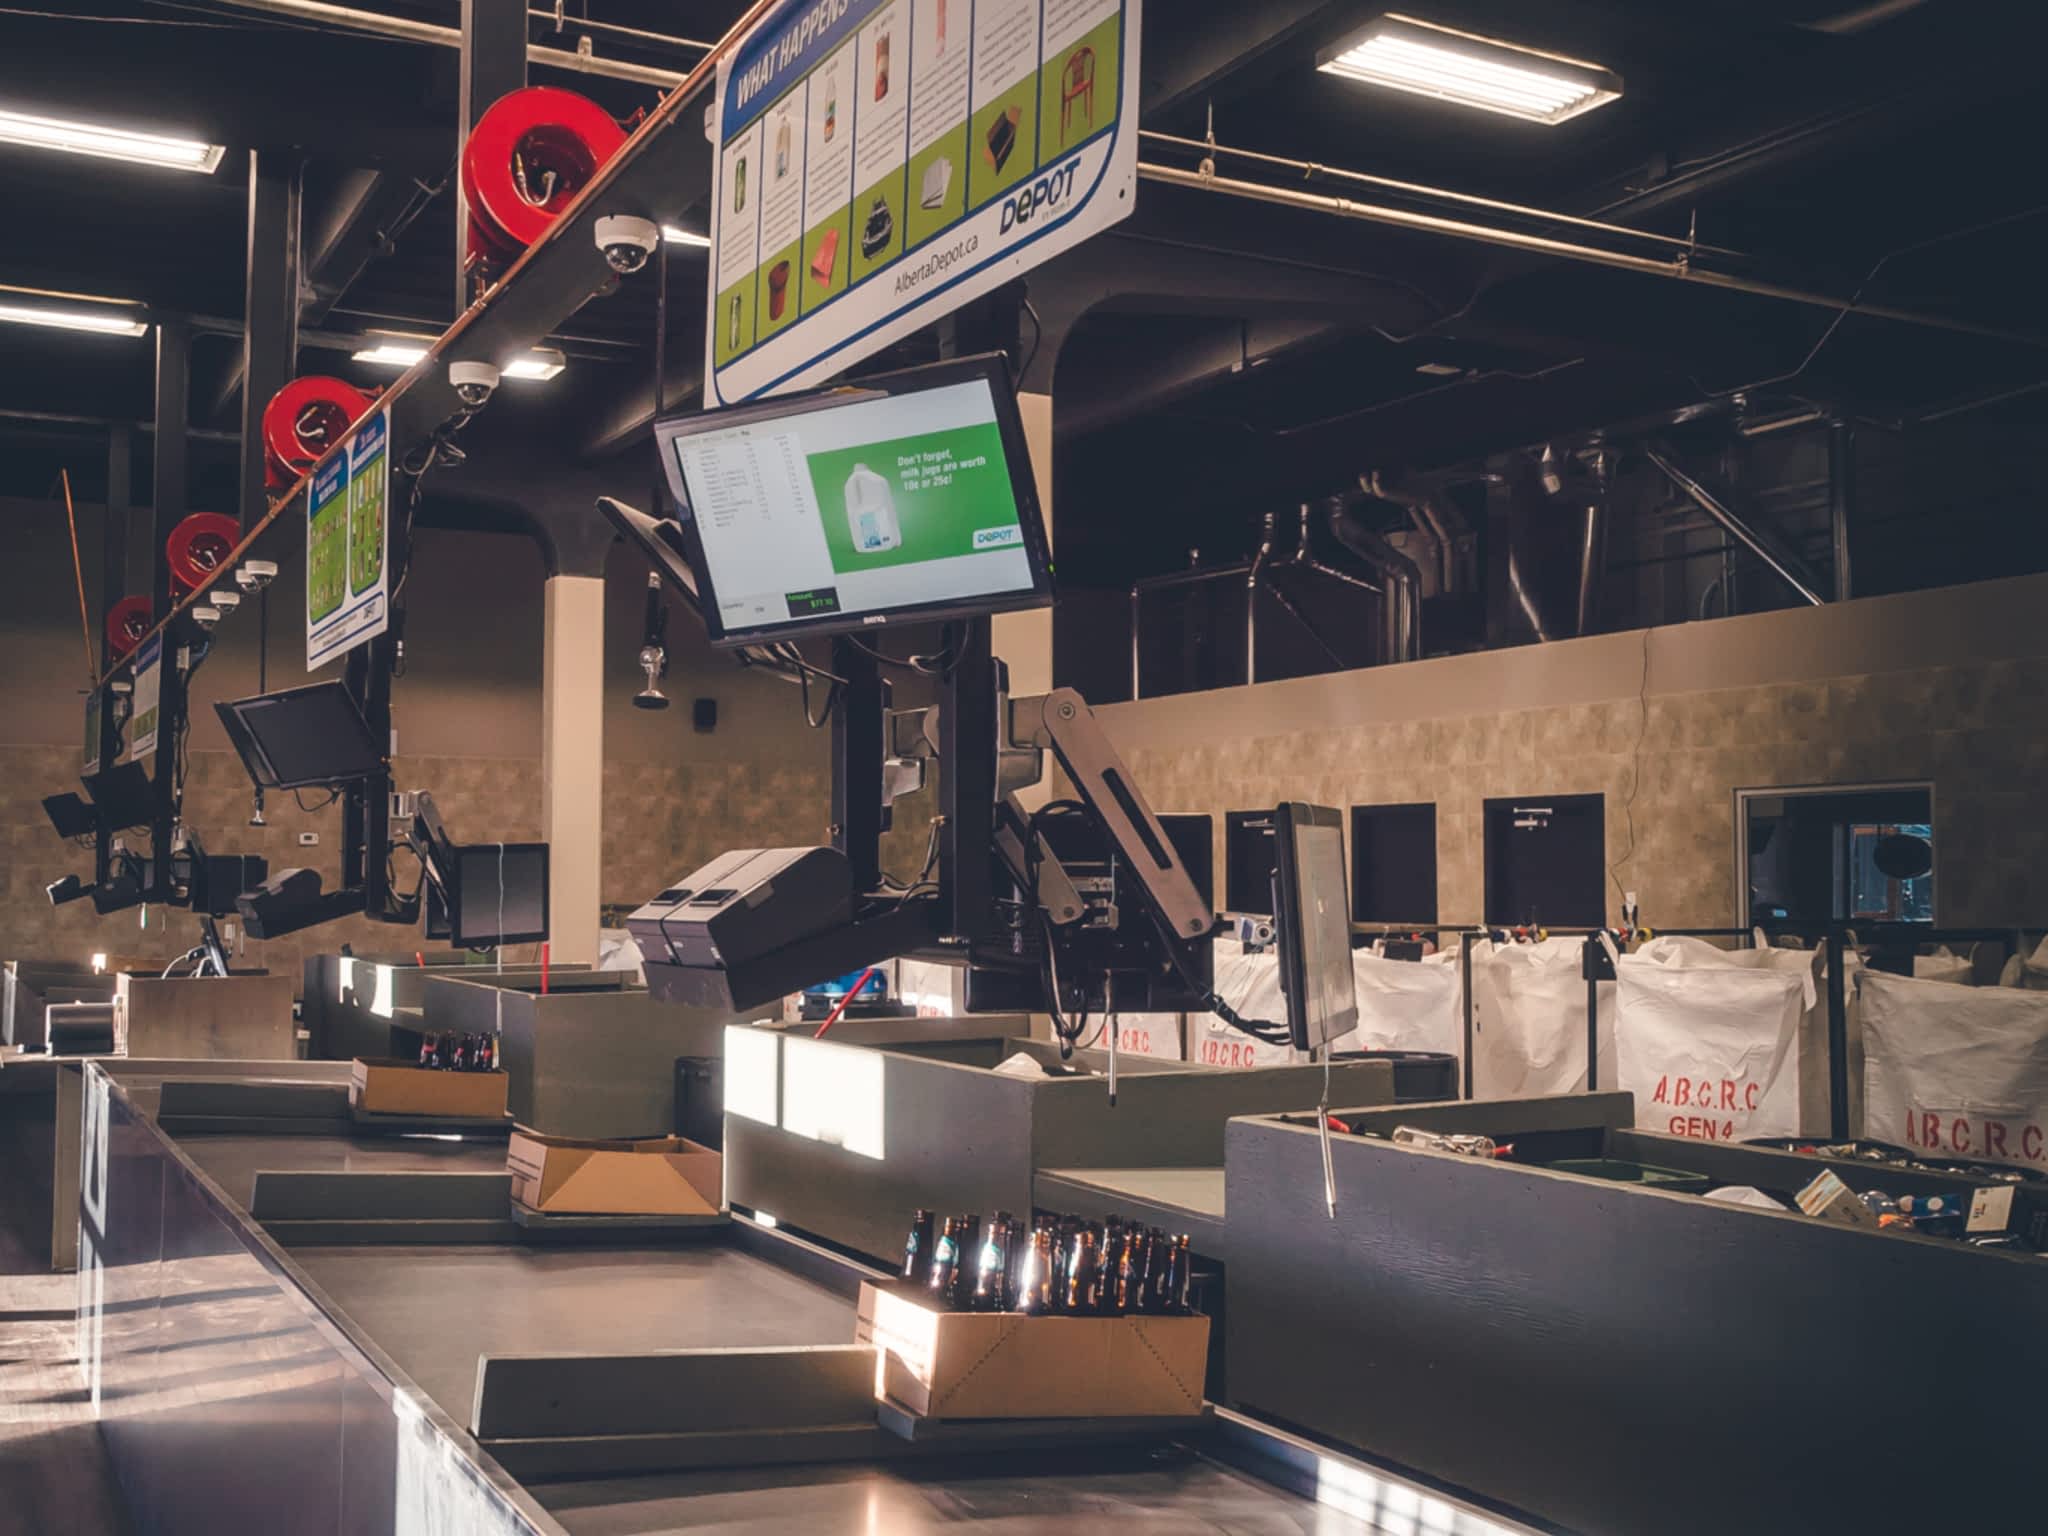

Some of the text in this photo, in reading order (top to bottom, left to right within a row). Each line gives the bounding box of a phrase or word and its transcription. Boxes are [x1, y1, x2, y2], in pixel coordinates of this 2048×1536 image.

[737, 0, 849, 110] WHAT HAPPENS
[894, 234, 979, 296] AlbertaDepot.ca
[897, 453, 921, 467] Don't
[960, 456, 986, 469] worth
[1669, 1115, 1733, 1140] GEN 4
